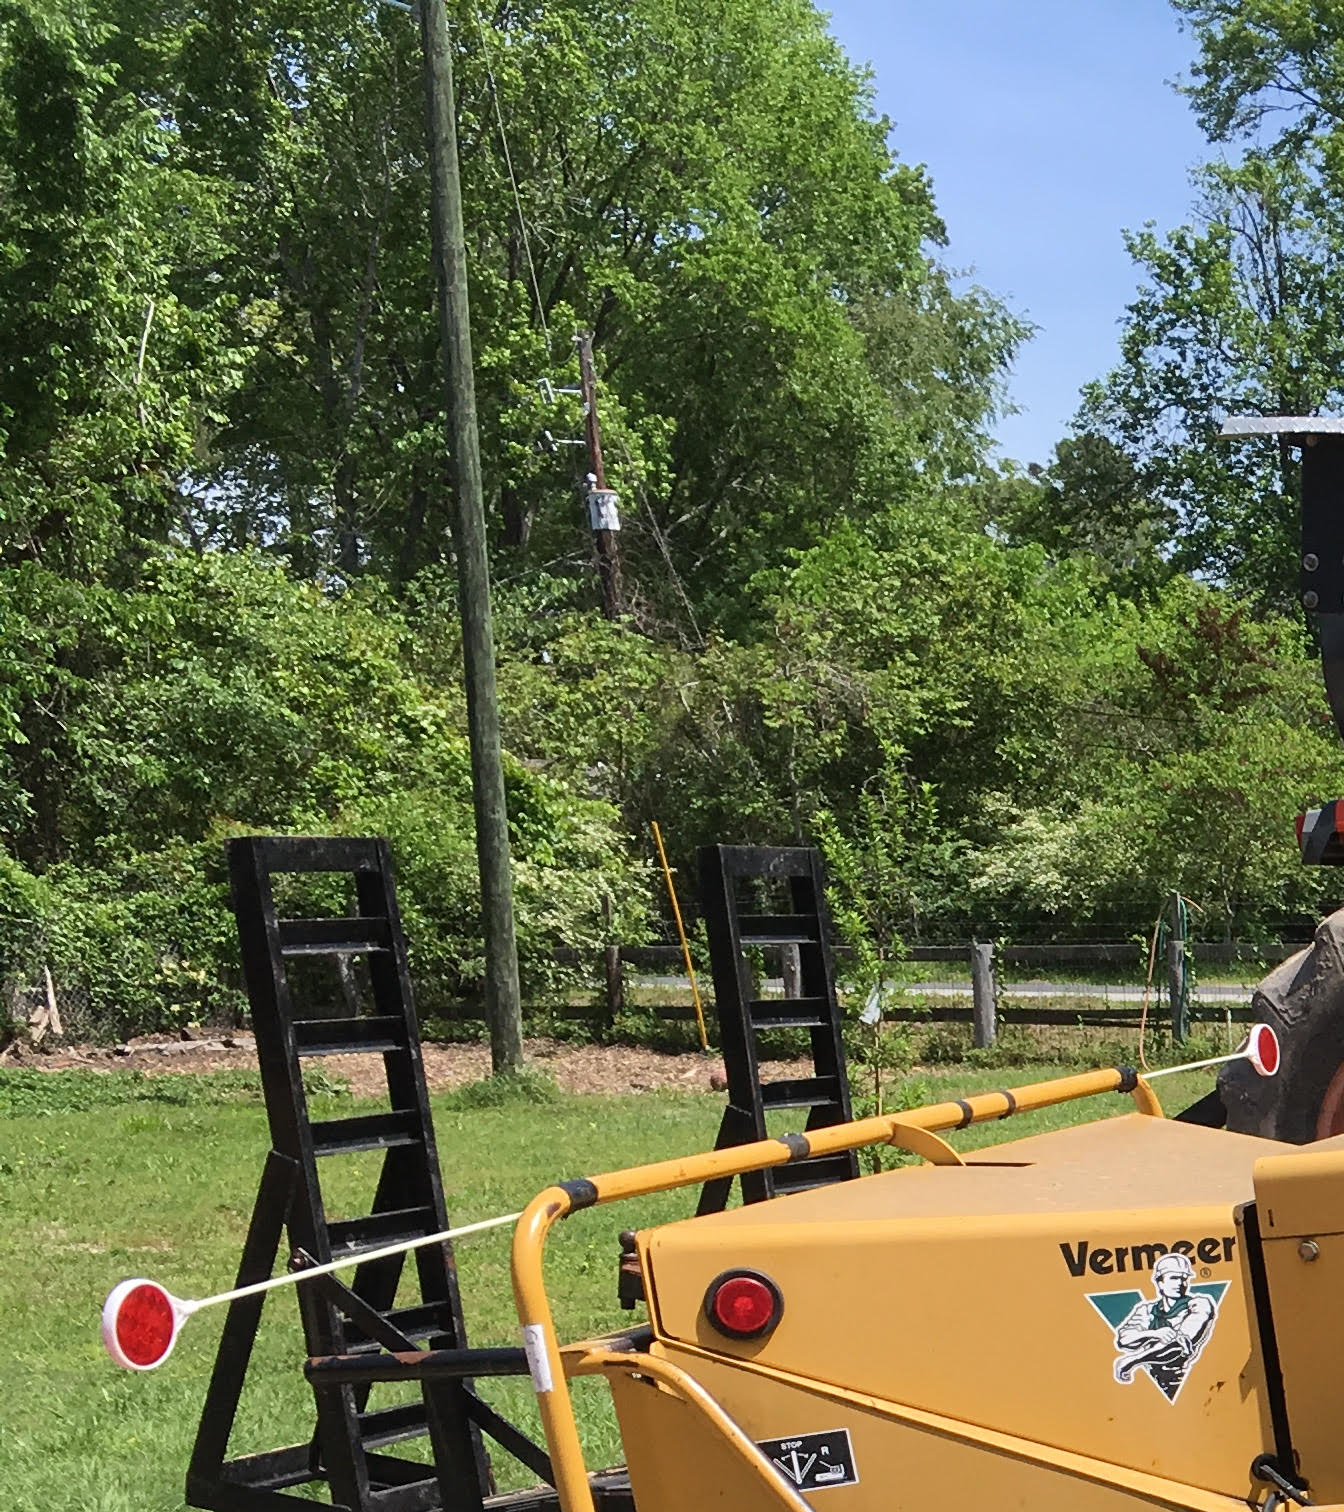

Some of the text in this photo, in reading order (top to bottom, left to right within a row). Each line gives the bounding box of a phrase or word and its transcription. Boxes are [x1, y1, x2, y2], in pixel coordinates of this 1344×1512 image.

[1059, 1235, 1236, 1278] Vermeer
[781, 1440, 830, 1456] STOP R
